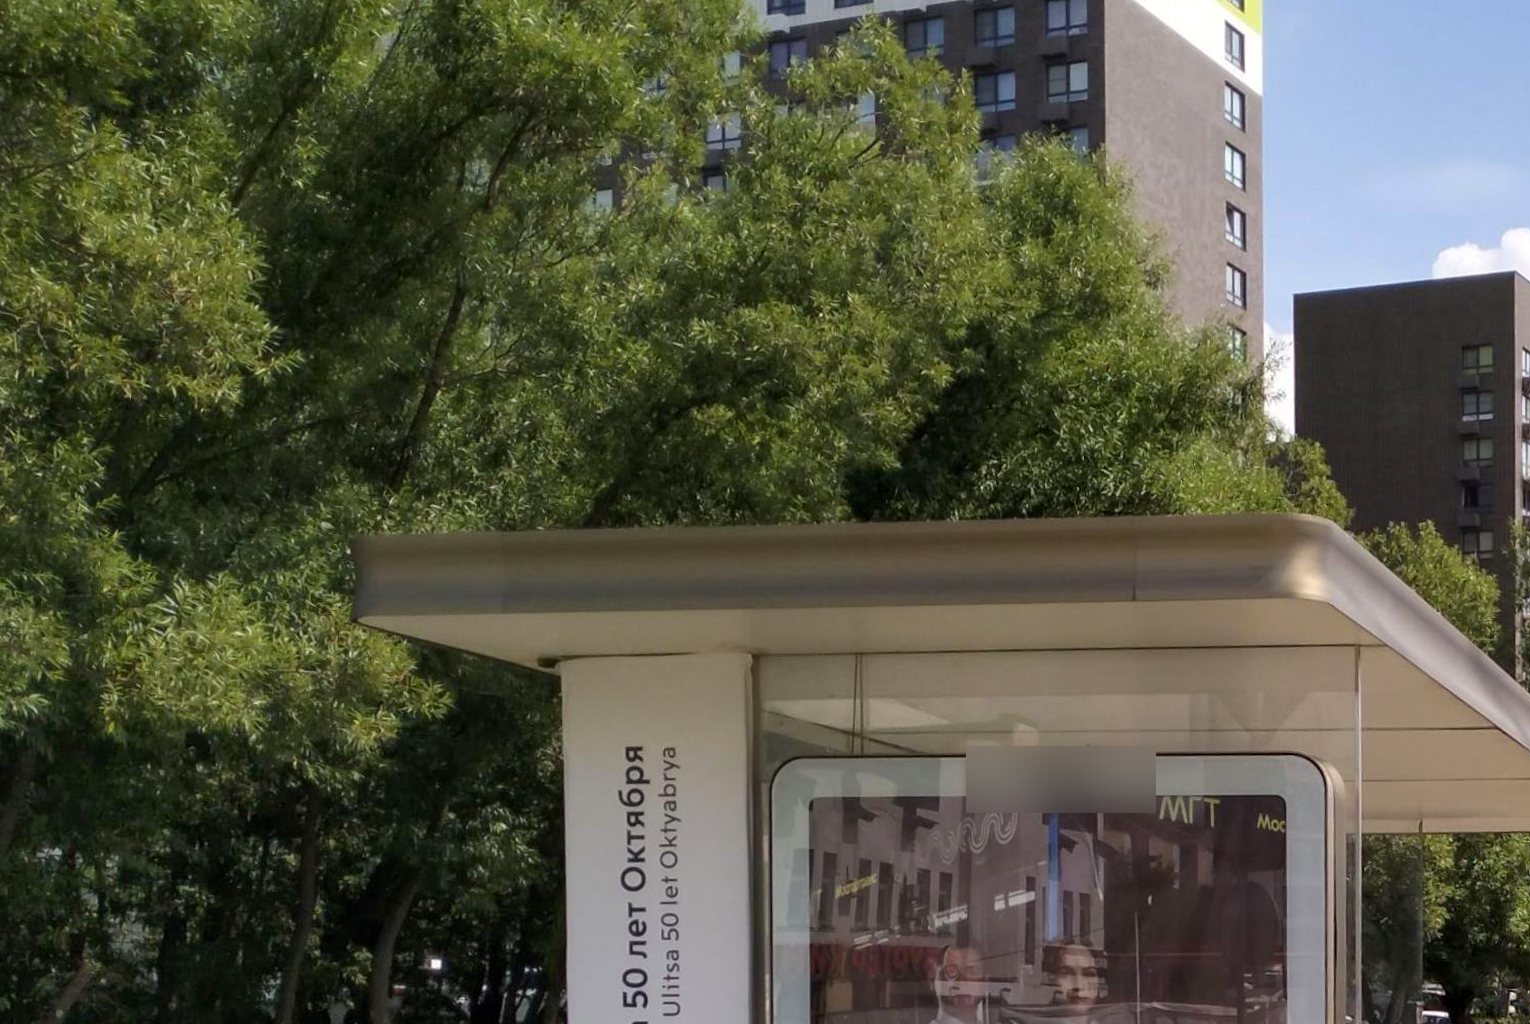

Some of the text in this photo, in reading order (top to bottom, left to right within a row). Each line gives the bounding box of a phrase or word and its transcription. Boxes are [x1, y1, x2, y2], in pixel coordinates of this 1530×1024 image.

[618, 746, 650, 892] Октября
[628, 902, 648, 959] лет
[658, 746, 682, 1017] Ulitsa 50 let Oktyabrya
[622, 968, 649, 1009] 50
